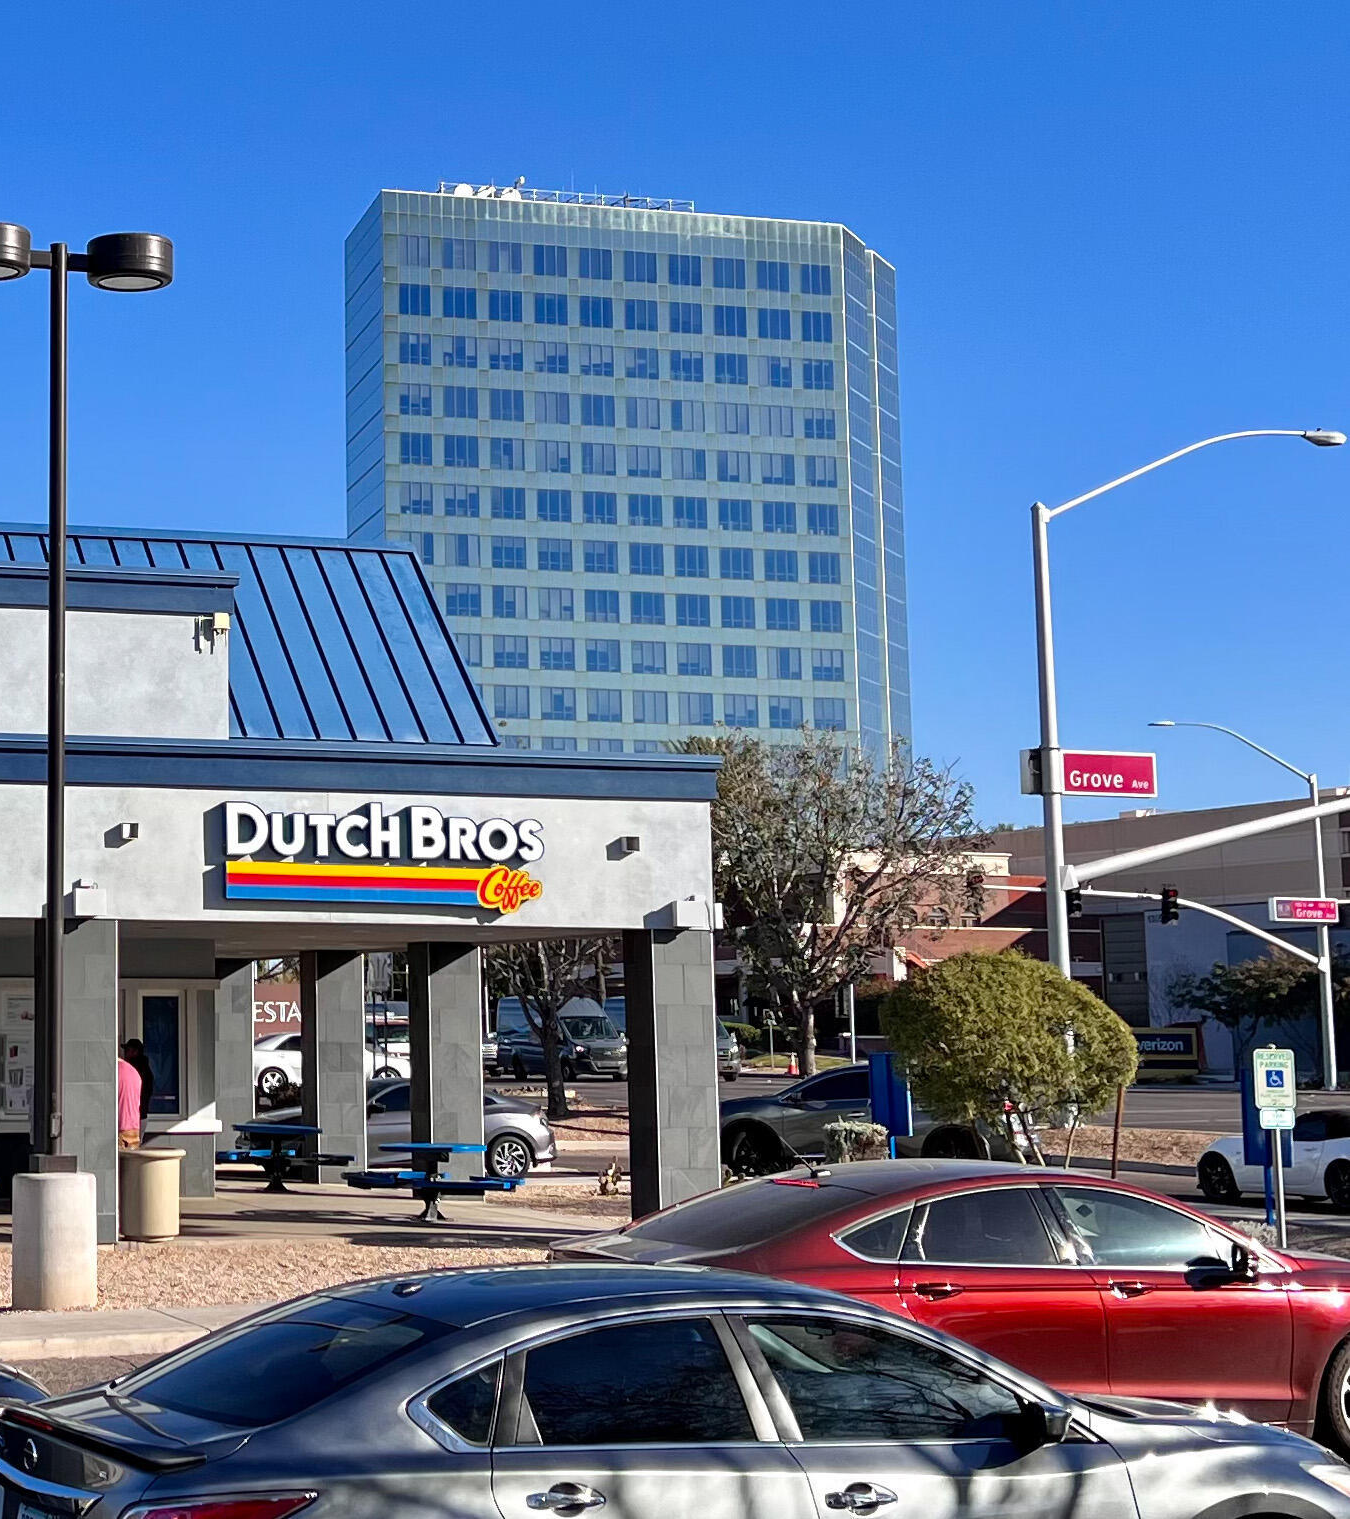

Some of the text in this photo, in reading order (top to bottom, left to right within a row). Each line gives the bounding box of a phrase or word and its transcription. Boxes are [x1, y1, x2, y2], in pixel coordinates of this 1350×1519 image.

[1070, 769, 1149, 790] Grove Ave
[226, 801, 544, 862] DUTCH BROS
[479, 866, 541, 910] Coffee
[1296, 908, 1323, 918] Grove
[1138, 1038, 1184, 1051] verizon
